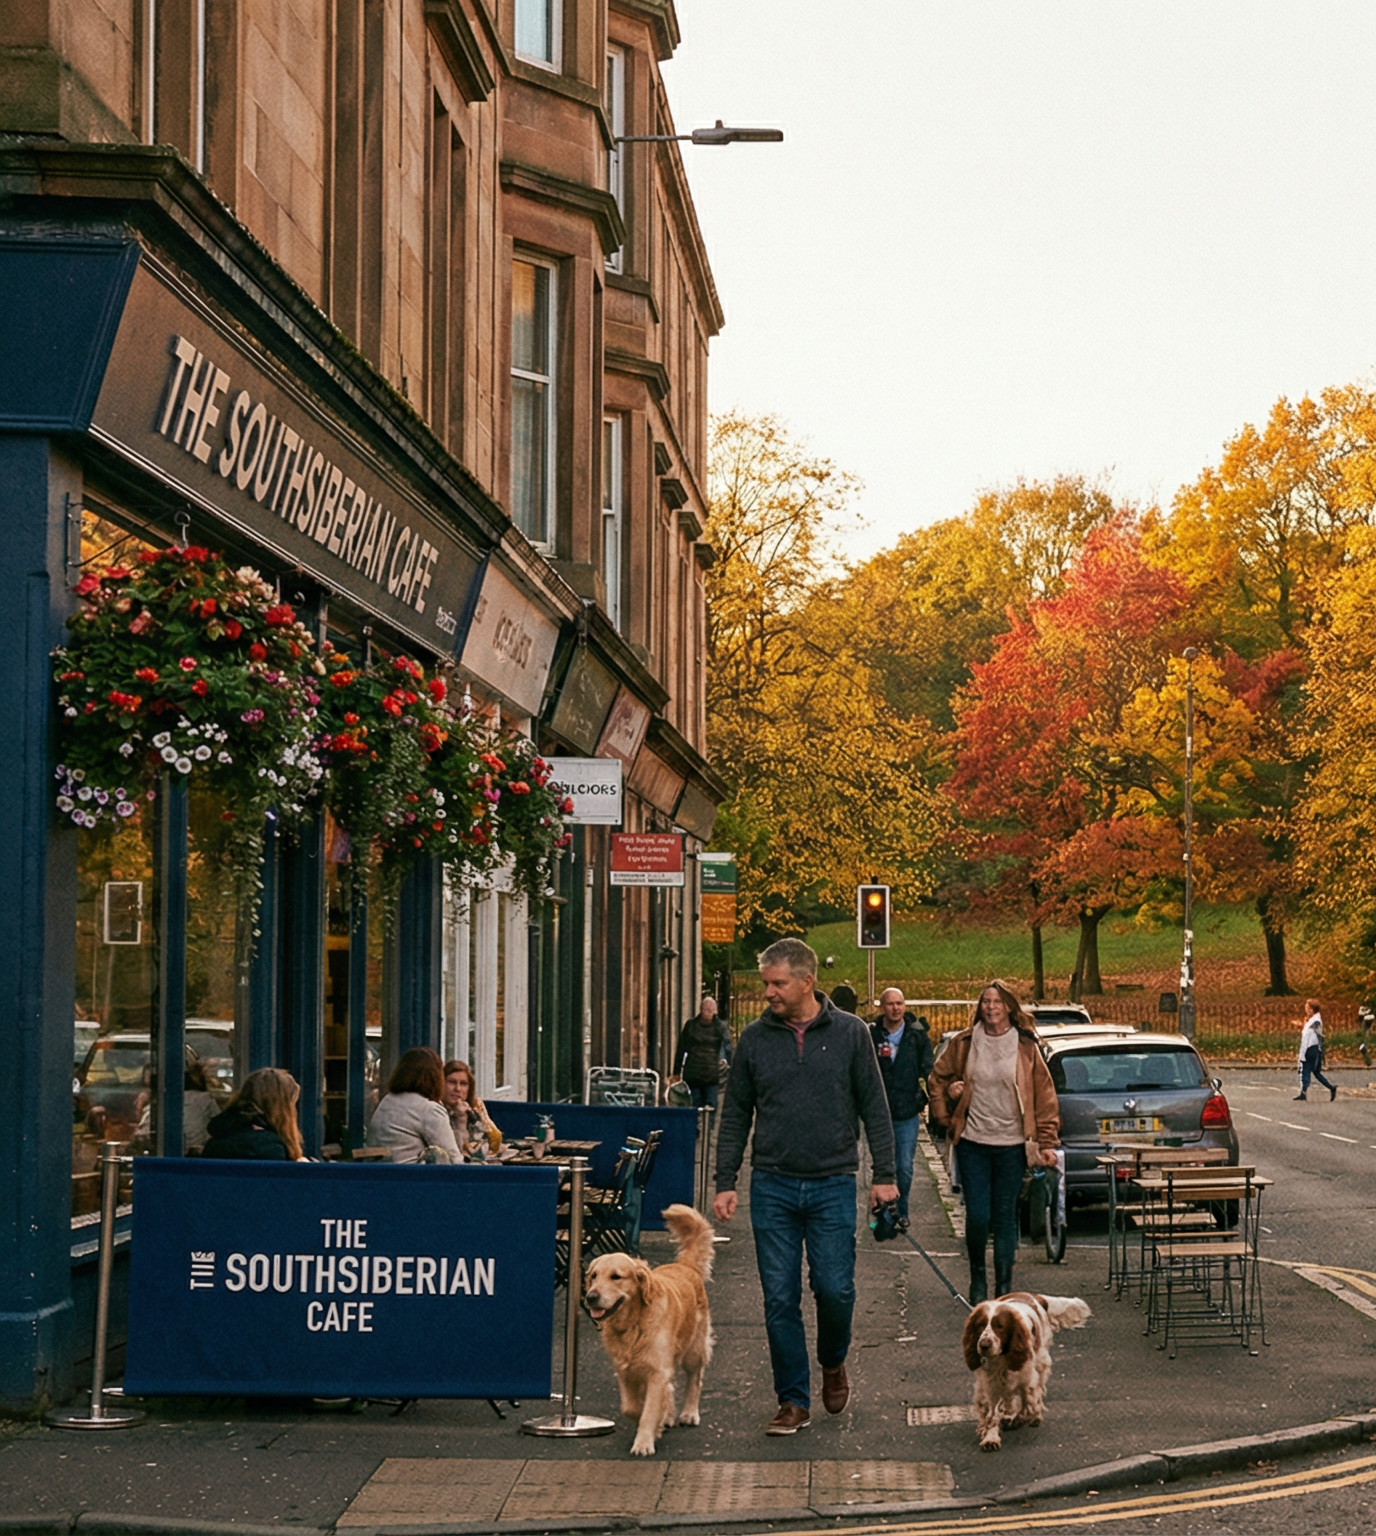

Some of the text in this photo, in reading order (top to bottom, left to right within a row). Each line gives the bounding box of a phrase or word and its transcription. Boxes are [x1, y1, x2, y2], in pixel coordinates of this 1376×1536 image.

[159, 334, 439, 614] THE SOUTHSIBERIAN CAFE
[320, 1219, 368, 1249] THE
[225, 1253, 496, 1296] SOUTHSIBERIAN
[306, 1301, 374, 1332] CAFE
